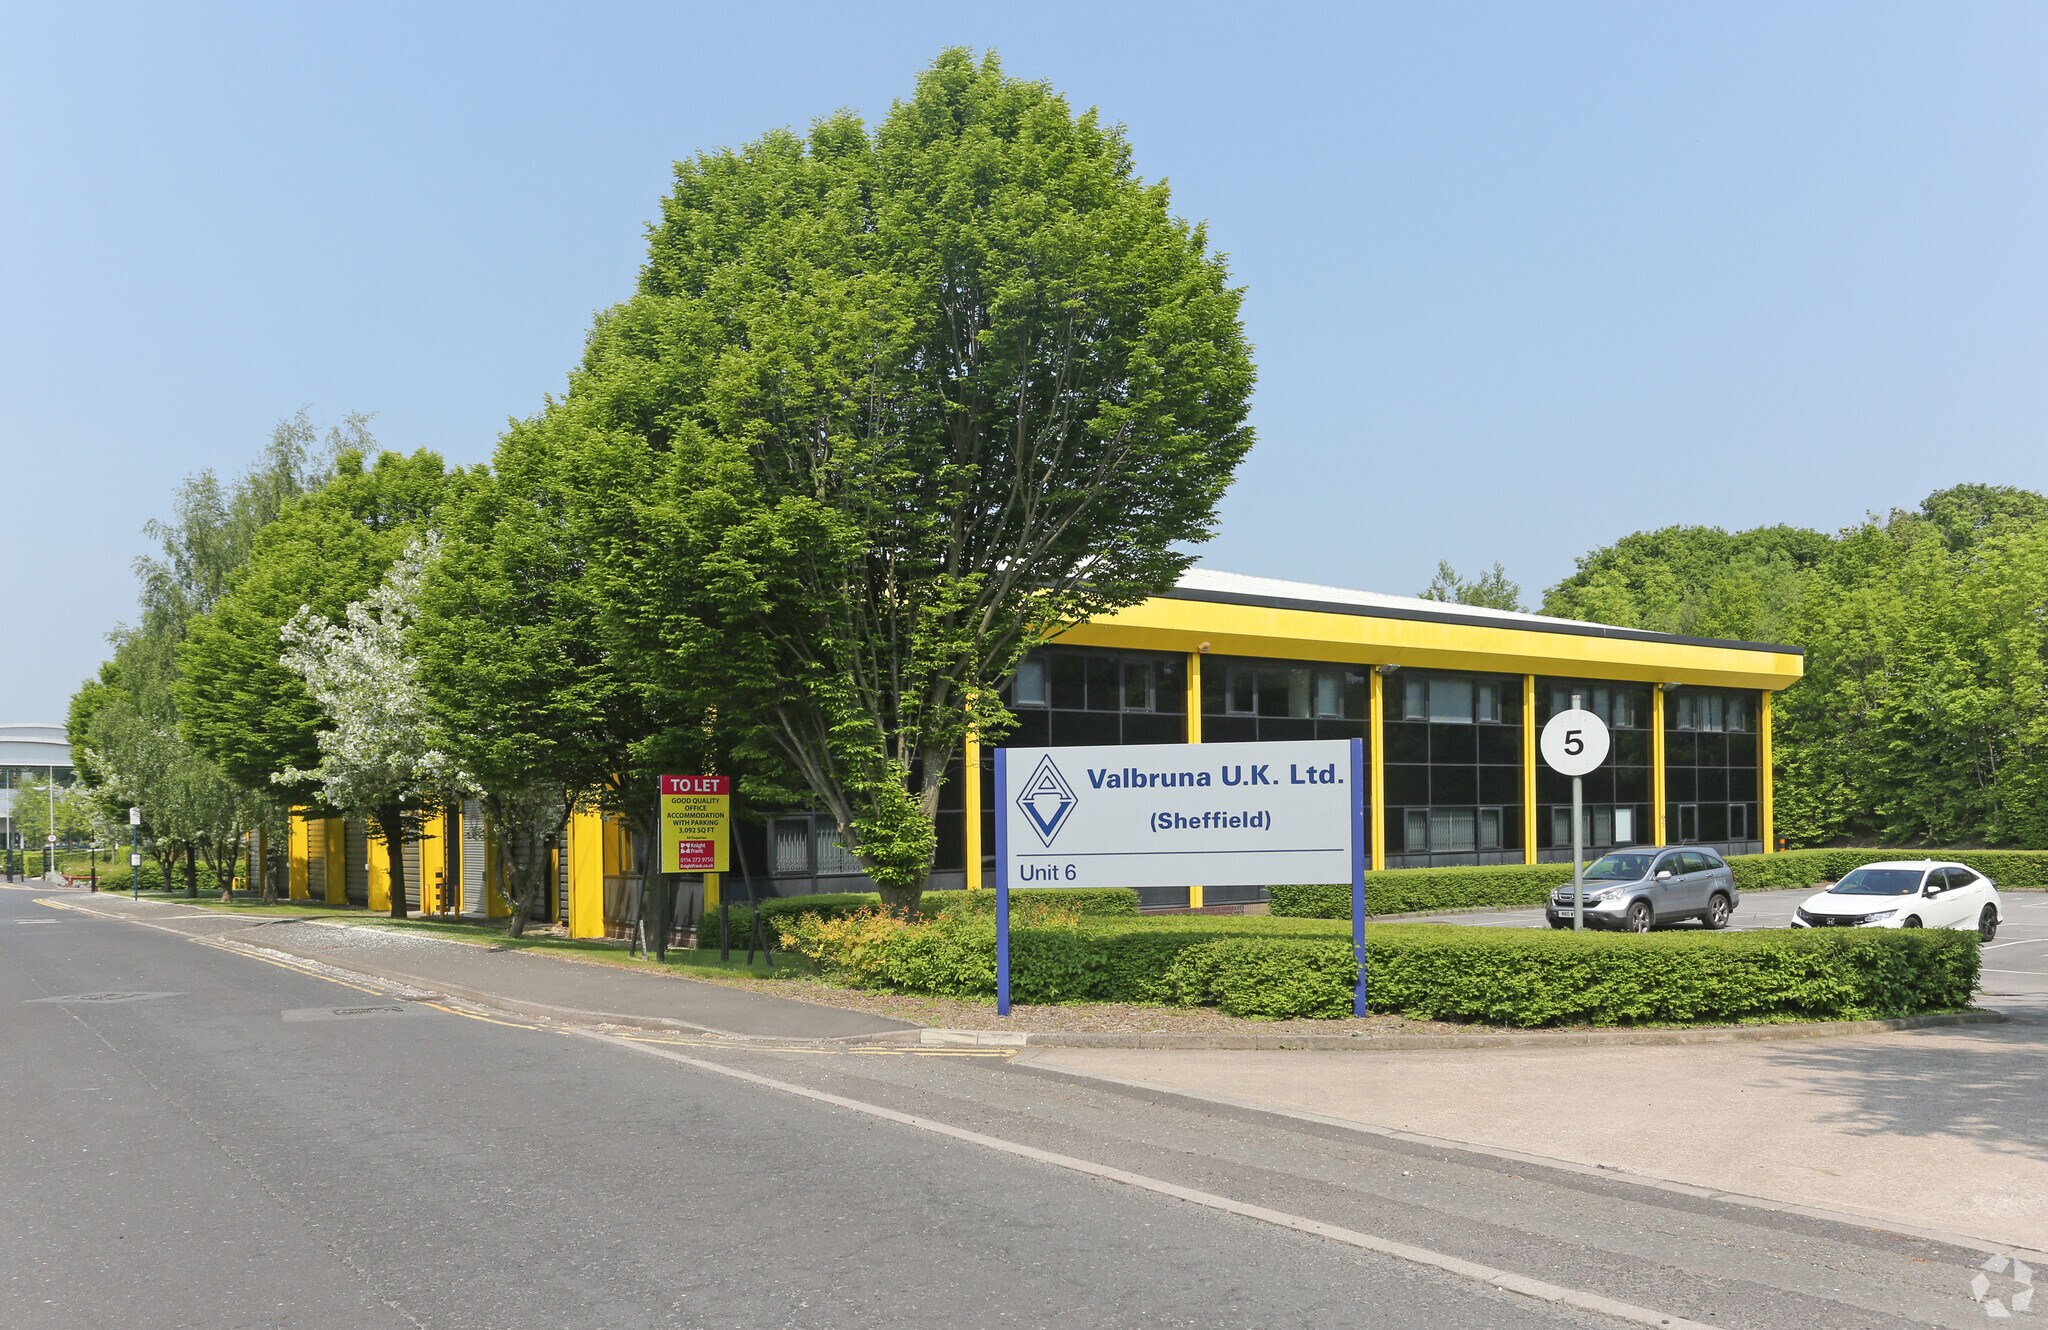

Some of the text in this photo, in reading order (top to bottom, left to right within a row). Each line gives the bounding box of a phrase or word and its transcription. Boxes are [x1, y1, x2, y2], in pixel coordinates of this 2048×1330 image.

[1564, 730, 1584, 756] 5
[671, 779, 720, 792] TO LET
[1087, 763, 1344, 789] Valbruna U.K. Ltd.
[692, 797, 720, 805] QUALITY
[1150, 810, 1272, 832] (Sheffield)
[1020, 863, 1077, 881] Unit 6
